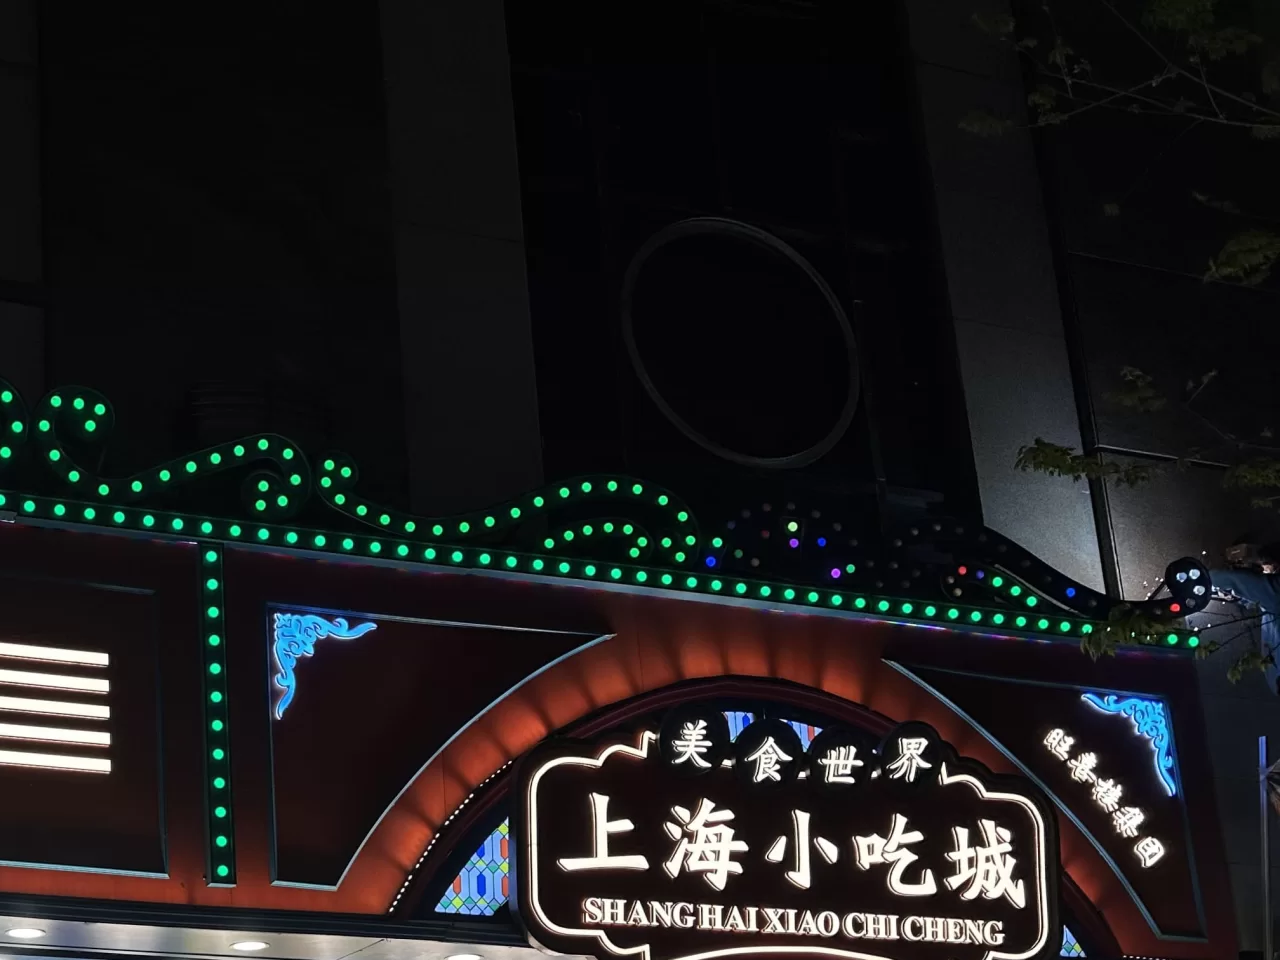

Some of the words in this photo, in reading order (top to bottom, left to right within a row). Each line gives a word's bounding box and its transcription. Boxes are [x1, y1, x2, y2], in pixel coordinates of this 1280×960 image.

[557, 791, 1027, 909] 上海小吃城
[1042, 727, 1166, 870] 旺喜楼集团
[762, 908, 841, 937] XIAO
[842, 912, 900, 942] CHI
[903, 916, 1006, 946] CHENG
